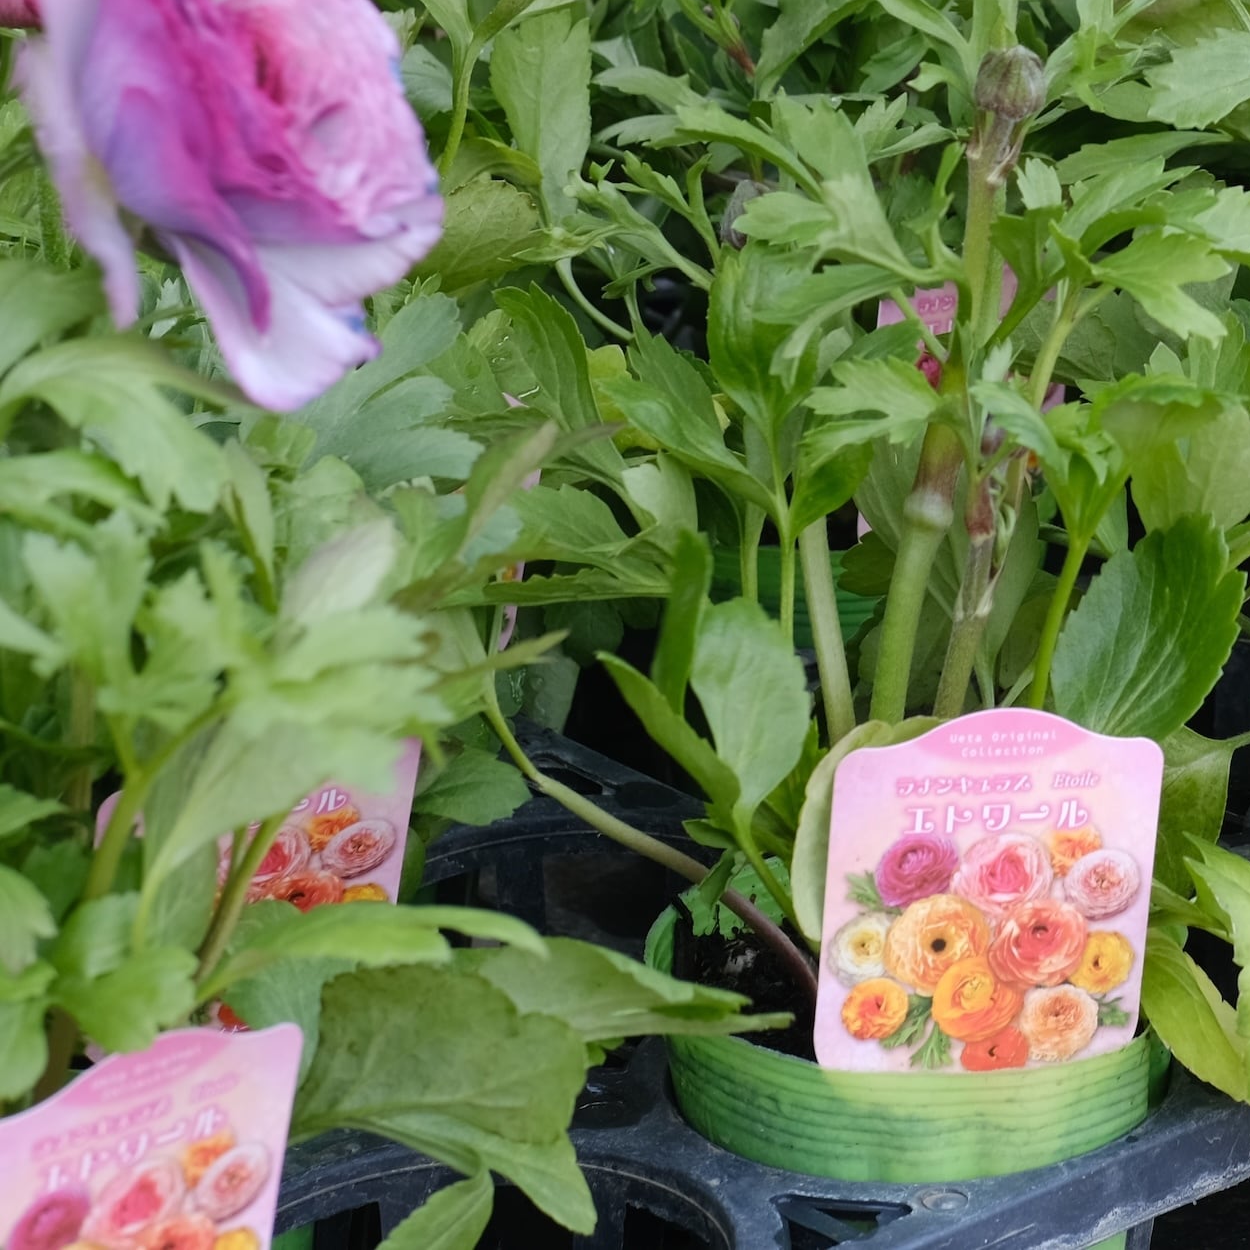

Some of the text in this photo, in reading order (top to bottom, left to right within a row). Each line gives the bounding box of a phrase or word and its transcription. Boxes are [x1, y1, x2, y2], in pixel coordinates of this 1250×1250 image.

[992, 731, 1057, 742] Original
[961, 746, 1044, 758] Collection
[904, 800, 1088, 835] エトワール
